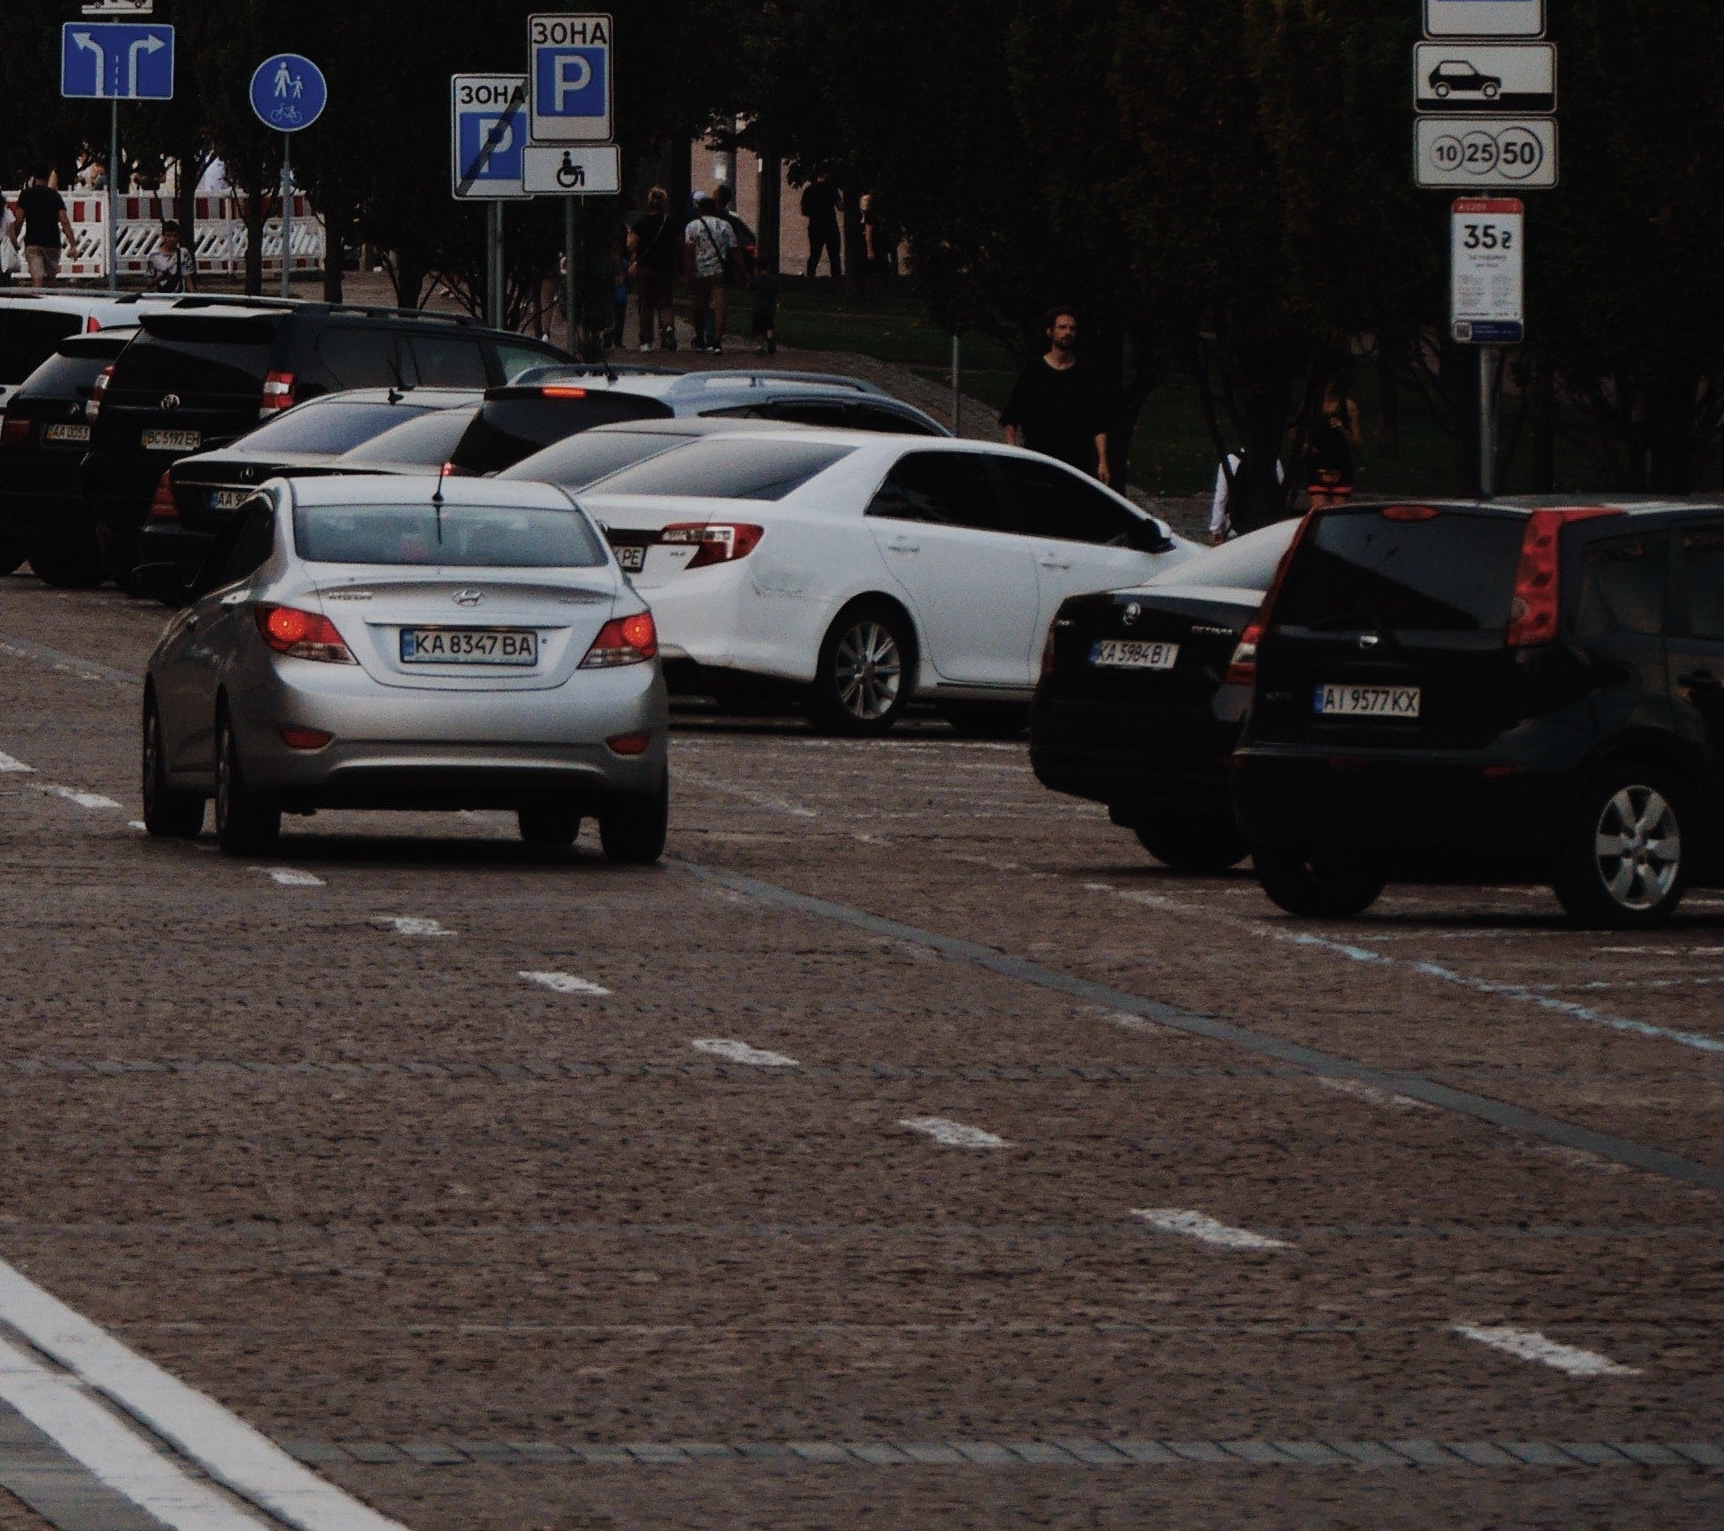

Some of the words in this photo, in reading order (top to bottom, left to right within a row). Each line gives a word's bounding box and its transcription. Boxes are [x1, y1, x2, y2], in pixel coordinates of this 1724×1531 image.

[533, 22, 608, 45] ЗОНА
[554, 54, 592, 112] P
[460, 85, 526, 105] ЗОНА
[479, 118, 513, 173] P
[1436, 145, 1457, 162] 10
[1466, 143, 1494, 162] 25
[1503, 141, 1535, 165] 50
[623, 548, 641, 565] PE
[415, 635, 445, 654] KA
[450, 635, 498, 655] 8347
[502, 636, 532, 656] BA
[1325, 688, 1345, 710] AI
[1352, 689, 1389, 711] 9577
[1392, 690, 1418, 712] KX
